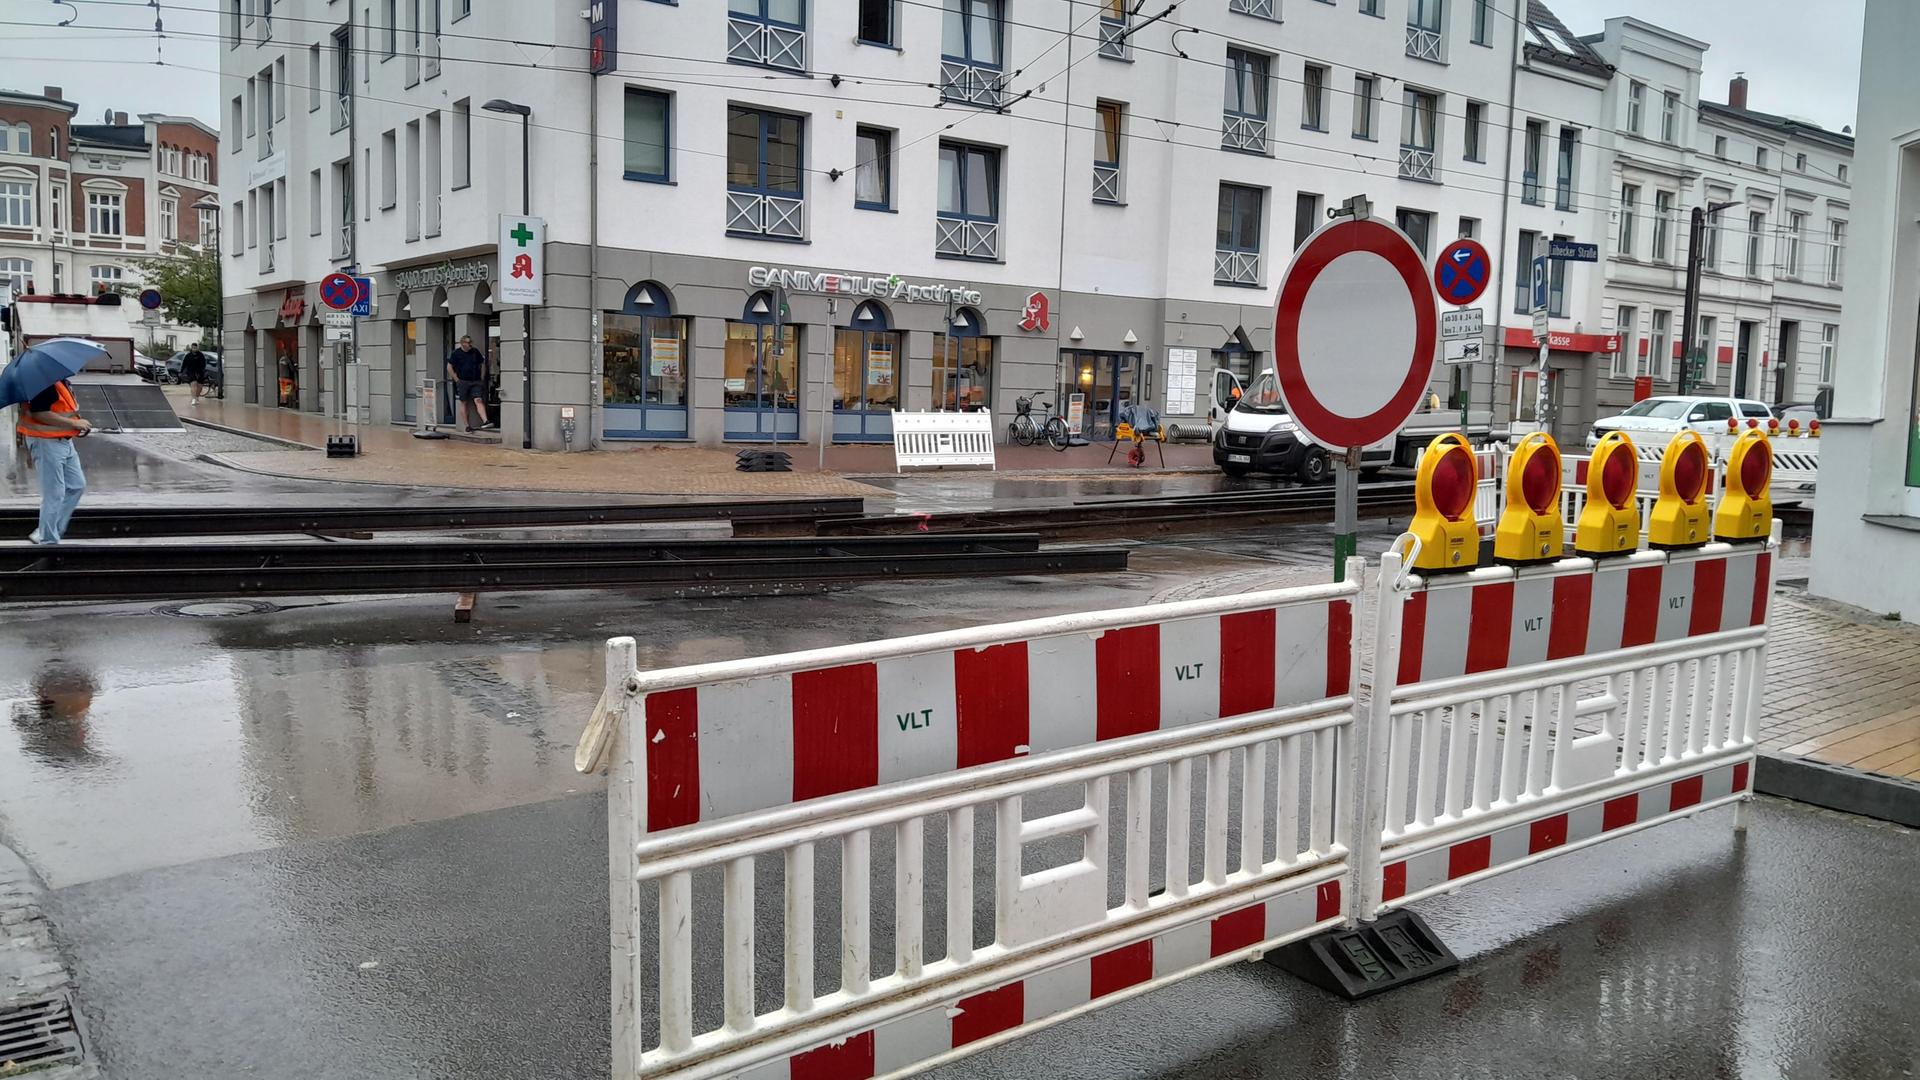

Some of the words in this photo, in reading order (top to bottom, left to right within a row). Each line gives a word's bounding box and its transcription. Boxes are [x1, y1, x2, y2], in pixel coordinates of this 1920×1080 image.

[1577, 246, 1597, 259] Straße
[1535, 263, 1543, 302] P
[1532, 333, 1571, 347] Spkasse
[1669, 596, 1686, 609] VLT
[1524, 617, 1543, 632] VLT
[1174, 663, 1204, 681] VLT
[896, 708, 933, 732] VLT
[1342, 942, 1385, 982] VLT
